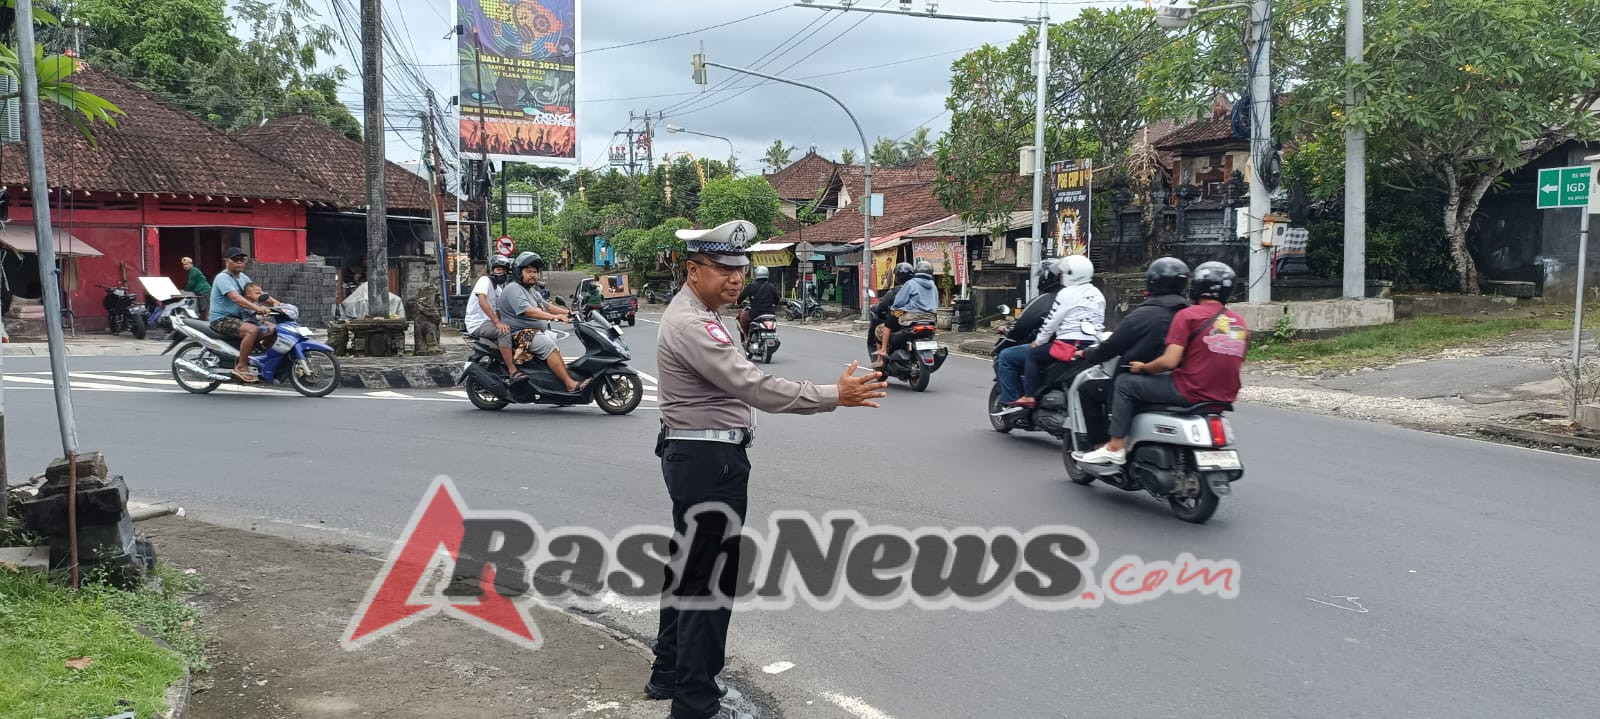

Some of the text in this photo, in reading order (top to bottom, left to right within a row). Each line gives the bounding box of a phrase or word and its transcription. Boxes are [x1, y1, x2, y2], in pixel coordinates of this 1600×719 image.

[539, 62, 560, 70] 2023
[1069, 171, 1078, 188] CUP
[1567, 183, 1585, 192] IGD
